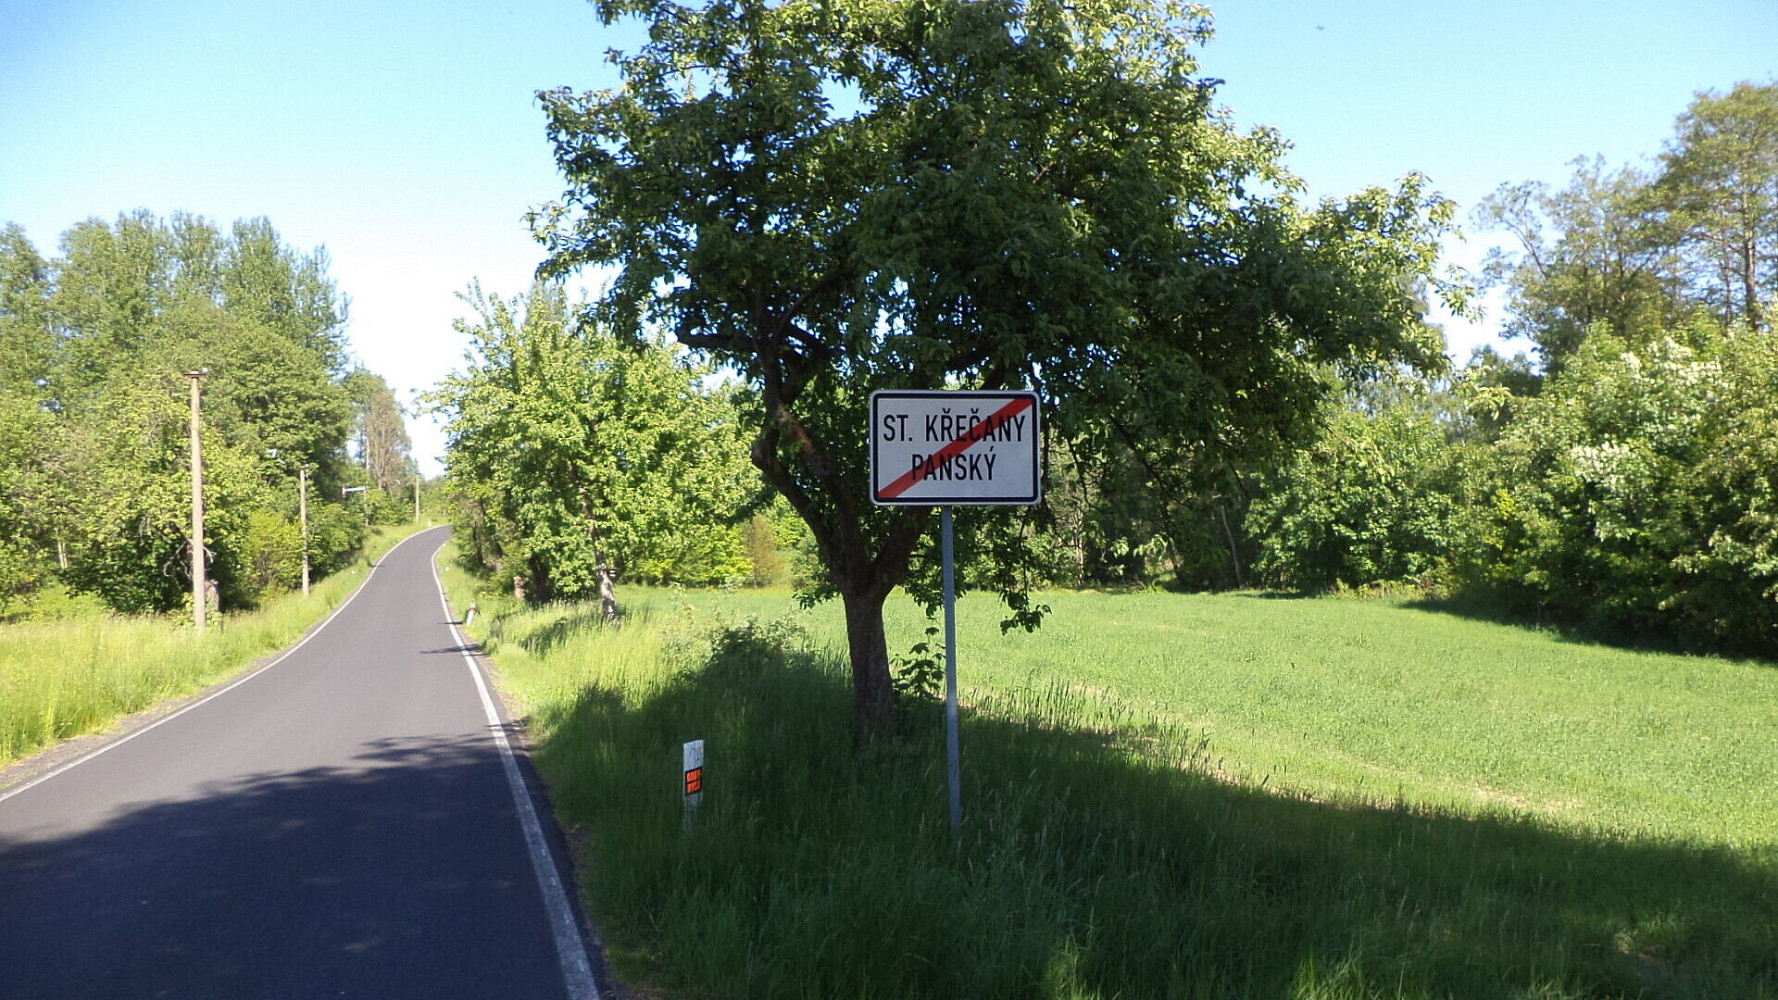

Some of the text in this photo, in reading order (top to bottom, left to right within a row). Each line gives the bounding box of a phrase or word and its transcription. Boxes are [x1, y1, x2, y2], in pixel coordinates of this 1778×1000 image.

[883, 408, 1026, 442] ST. KŘEČANY
[911, 446, 997, 481] PANSKÝ
